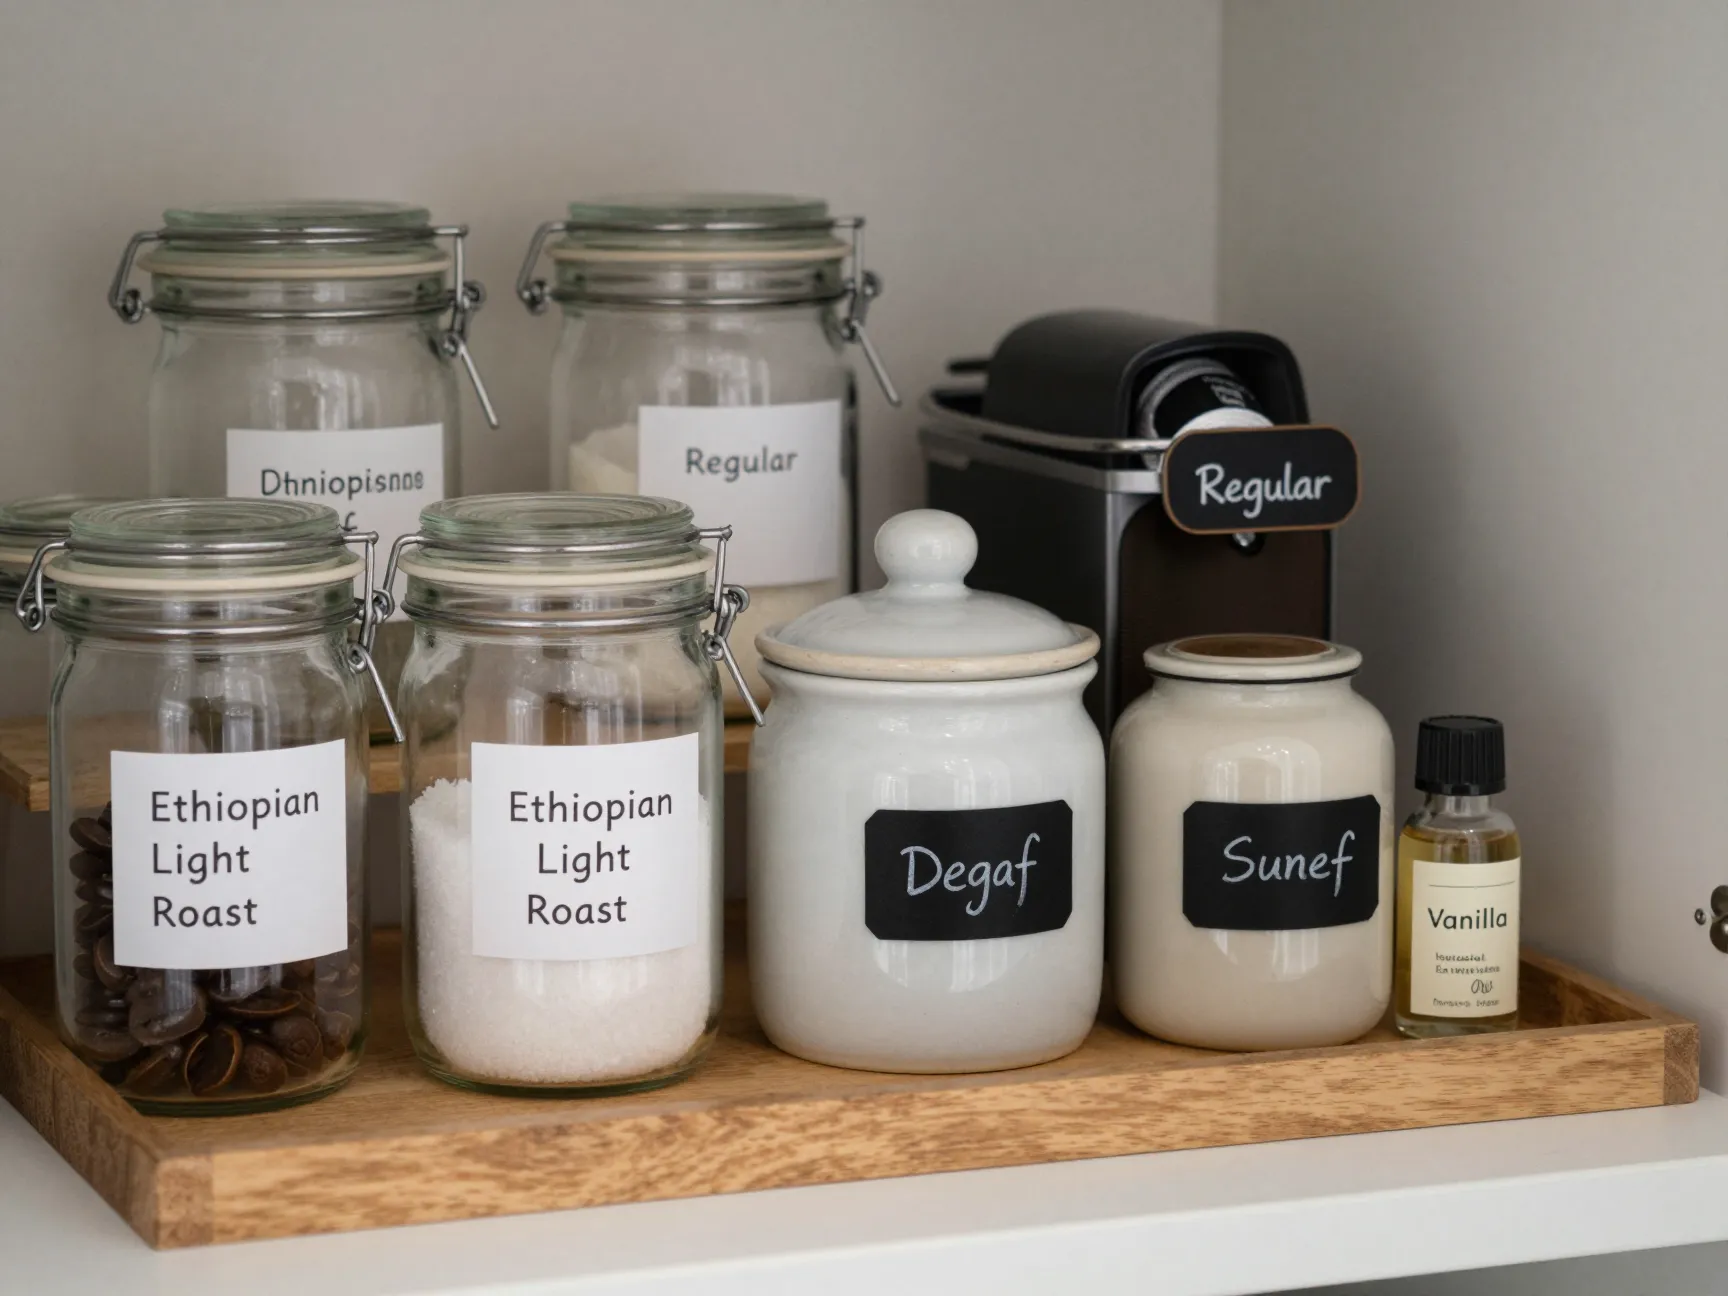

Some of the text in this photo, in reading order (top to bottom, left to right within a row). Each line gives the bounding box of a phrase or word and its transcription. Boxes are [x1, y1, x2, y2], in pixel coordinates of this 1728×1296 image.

[685, 445, 798, 483] Regular
[1195, 461, 1332, 519] Regular
[151, 788, 319, 830] Ethiopian
[510, 790, 673, 832] Ethiopian
[152, 841, 250, 885] Light
[538, 841, 631, 883] Light
[900, 832, 1041, 916] Degaf
[1222, 829, 1356, 898] Sunef
[153, 896, 258, 928] Roast
[527, 894, 628, 926] Roast
[1427, 907, 1508, 930] Vanilla
